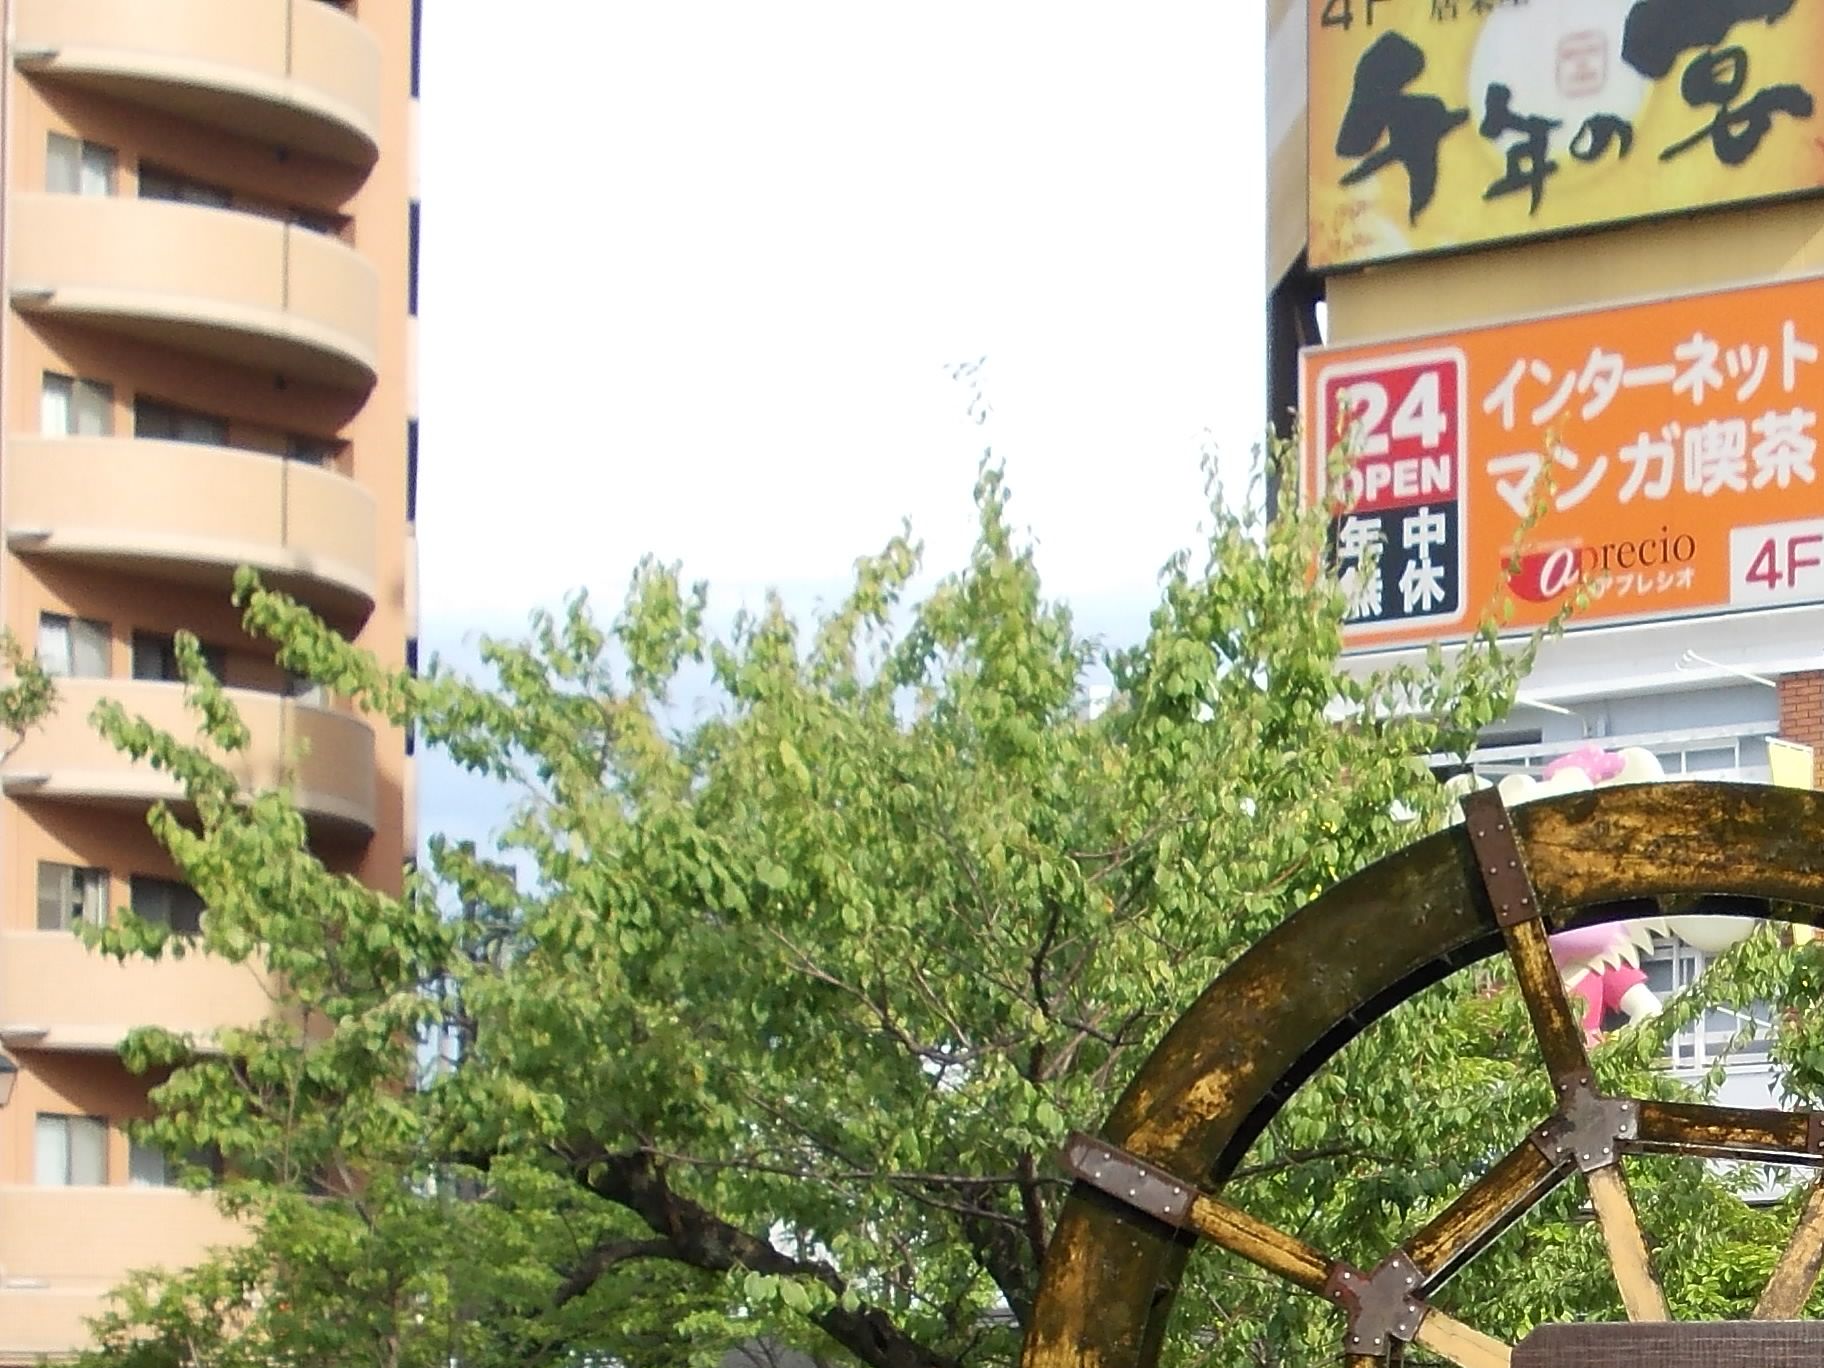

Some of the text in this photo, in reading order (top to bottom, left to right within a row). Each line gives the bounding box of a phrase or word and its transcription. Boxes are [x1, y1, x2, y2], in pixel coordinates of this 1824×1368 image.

[1336, 0, 1813, 226] 千年の宴
[1344, 372, 1447, 455] 24
[1483, 320, 1818, 431] インターネット
[1341, 455, 1450, 505] OPEN
[1486, 407, 1817, 518] マンガ喫茶
[1745, 534, 1824, 590] 4F
